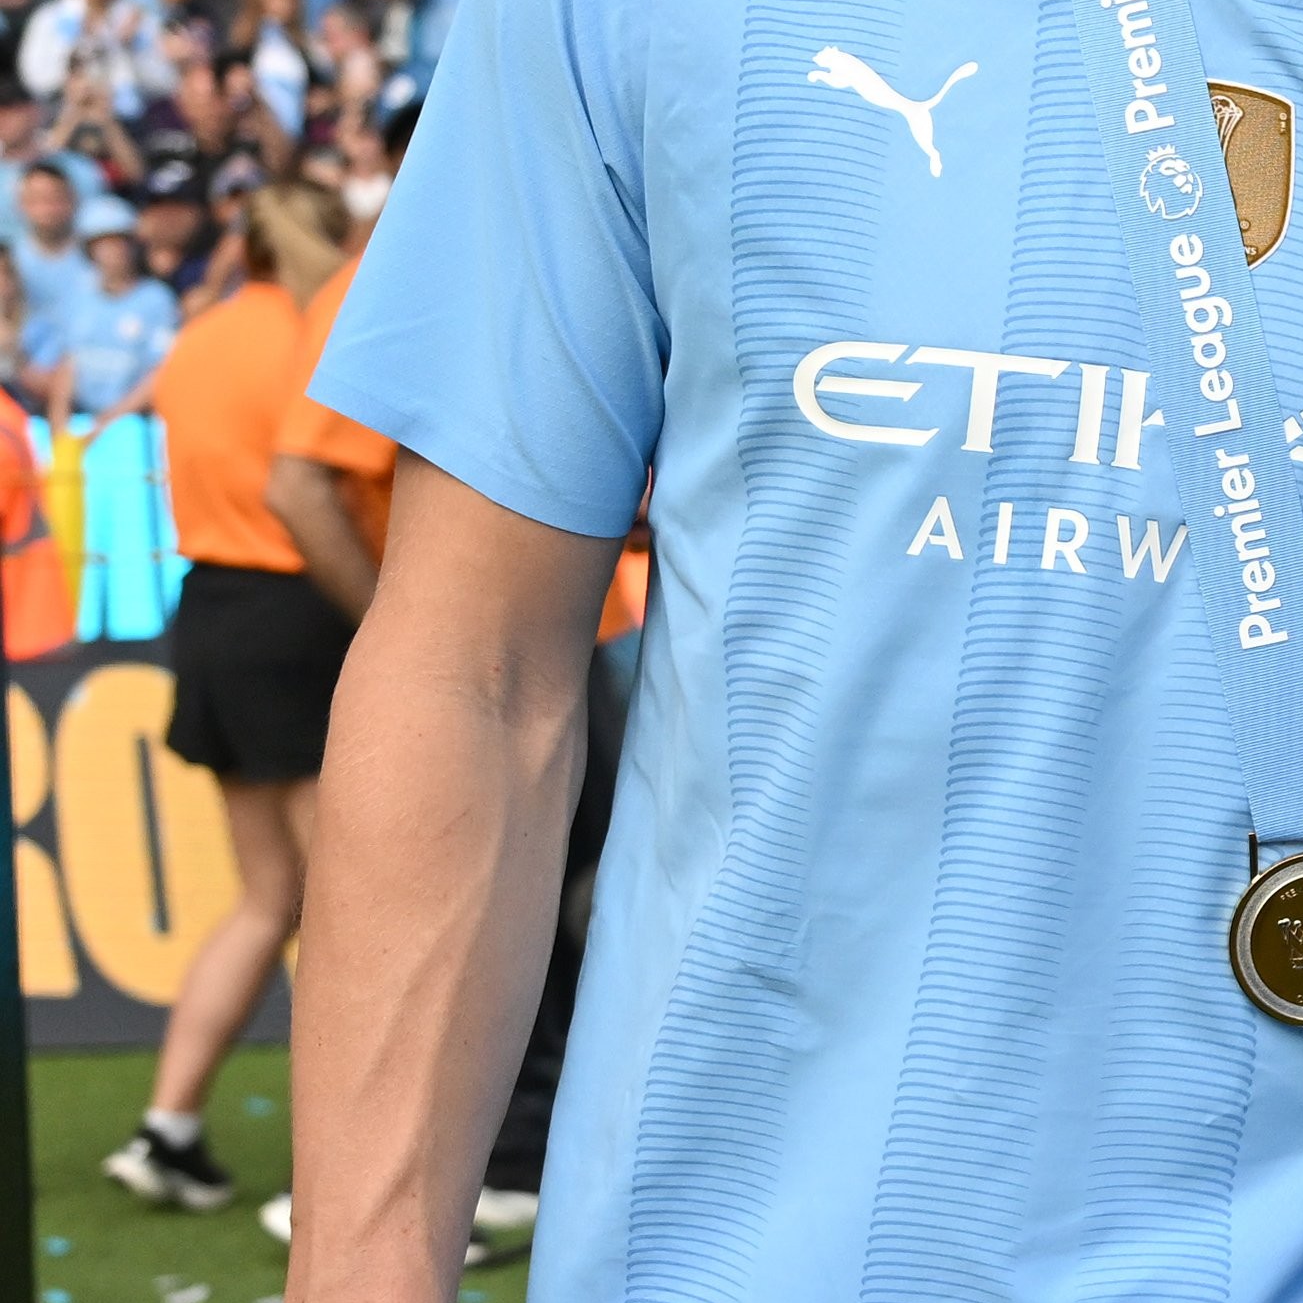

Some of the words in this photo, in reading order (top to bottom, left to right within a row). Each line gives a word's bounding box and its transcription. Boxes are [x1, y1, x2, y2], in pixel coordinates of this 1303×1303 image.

[1170, 233, 1243, 436] League
[905, 496, 1188, 583] AIRW
[1214, 449, 1288, 651] Premier
